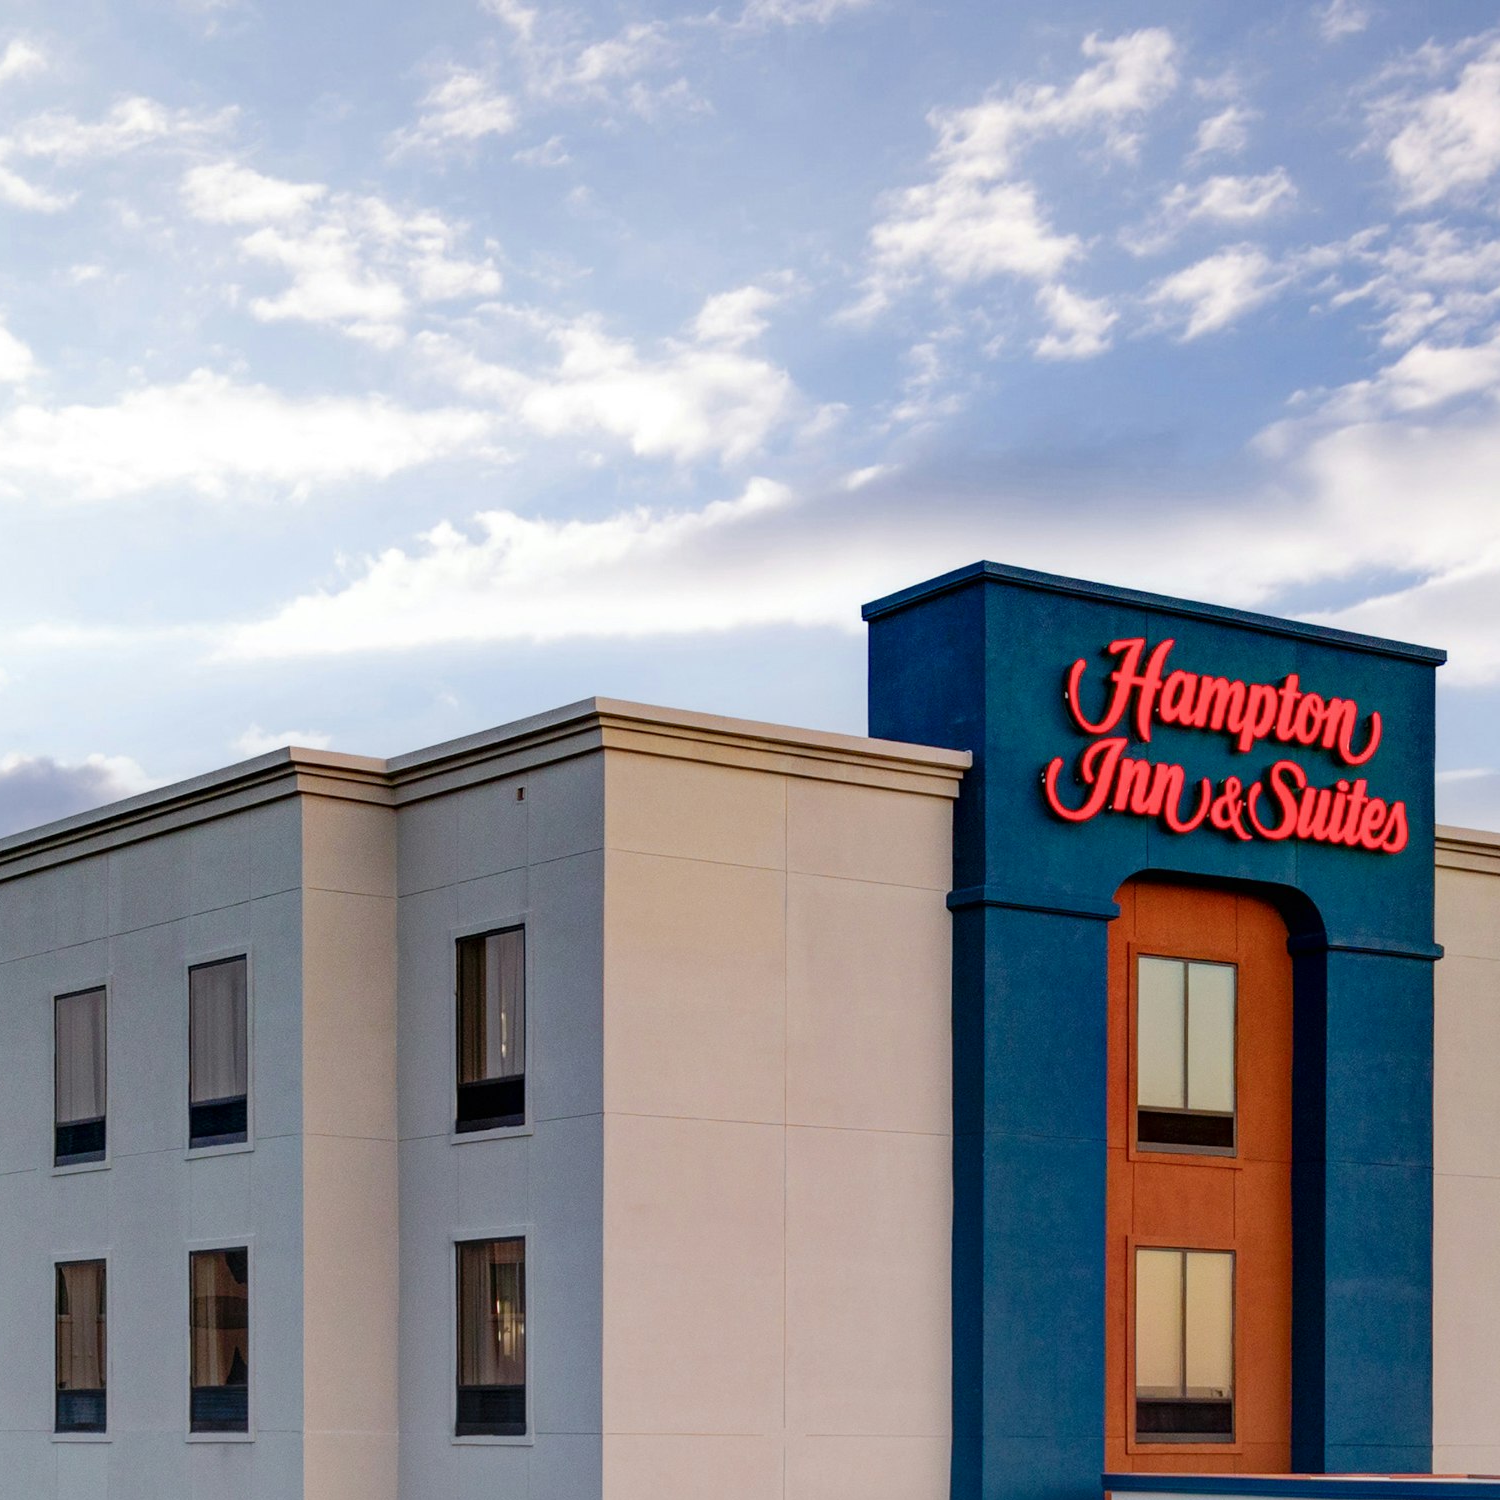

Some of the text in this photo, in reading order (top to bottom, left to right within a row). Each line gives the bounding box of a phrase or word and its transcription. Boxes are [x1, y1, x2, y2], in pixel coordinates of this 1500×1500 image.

[1067, 638, 1382, 766] Hampton
[1044, 737, 1410, 854] Inn & Suites
